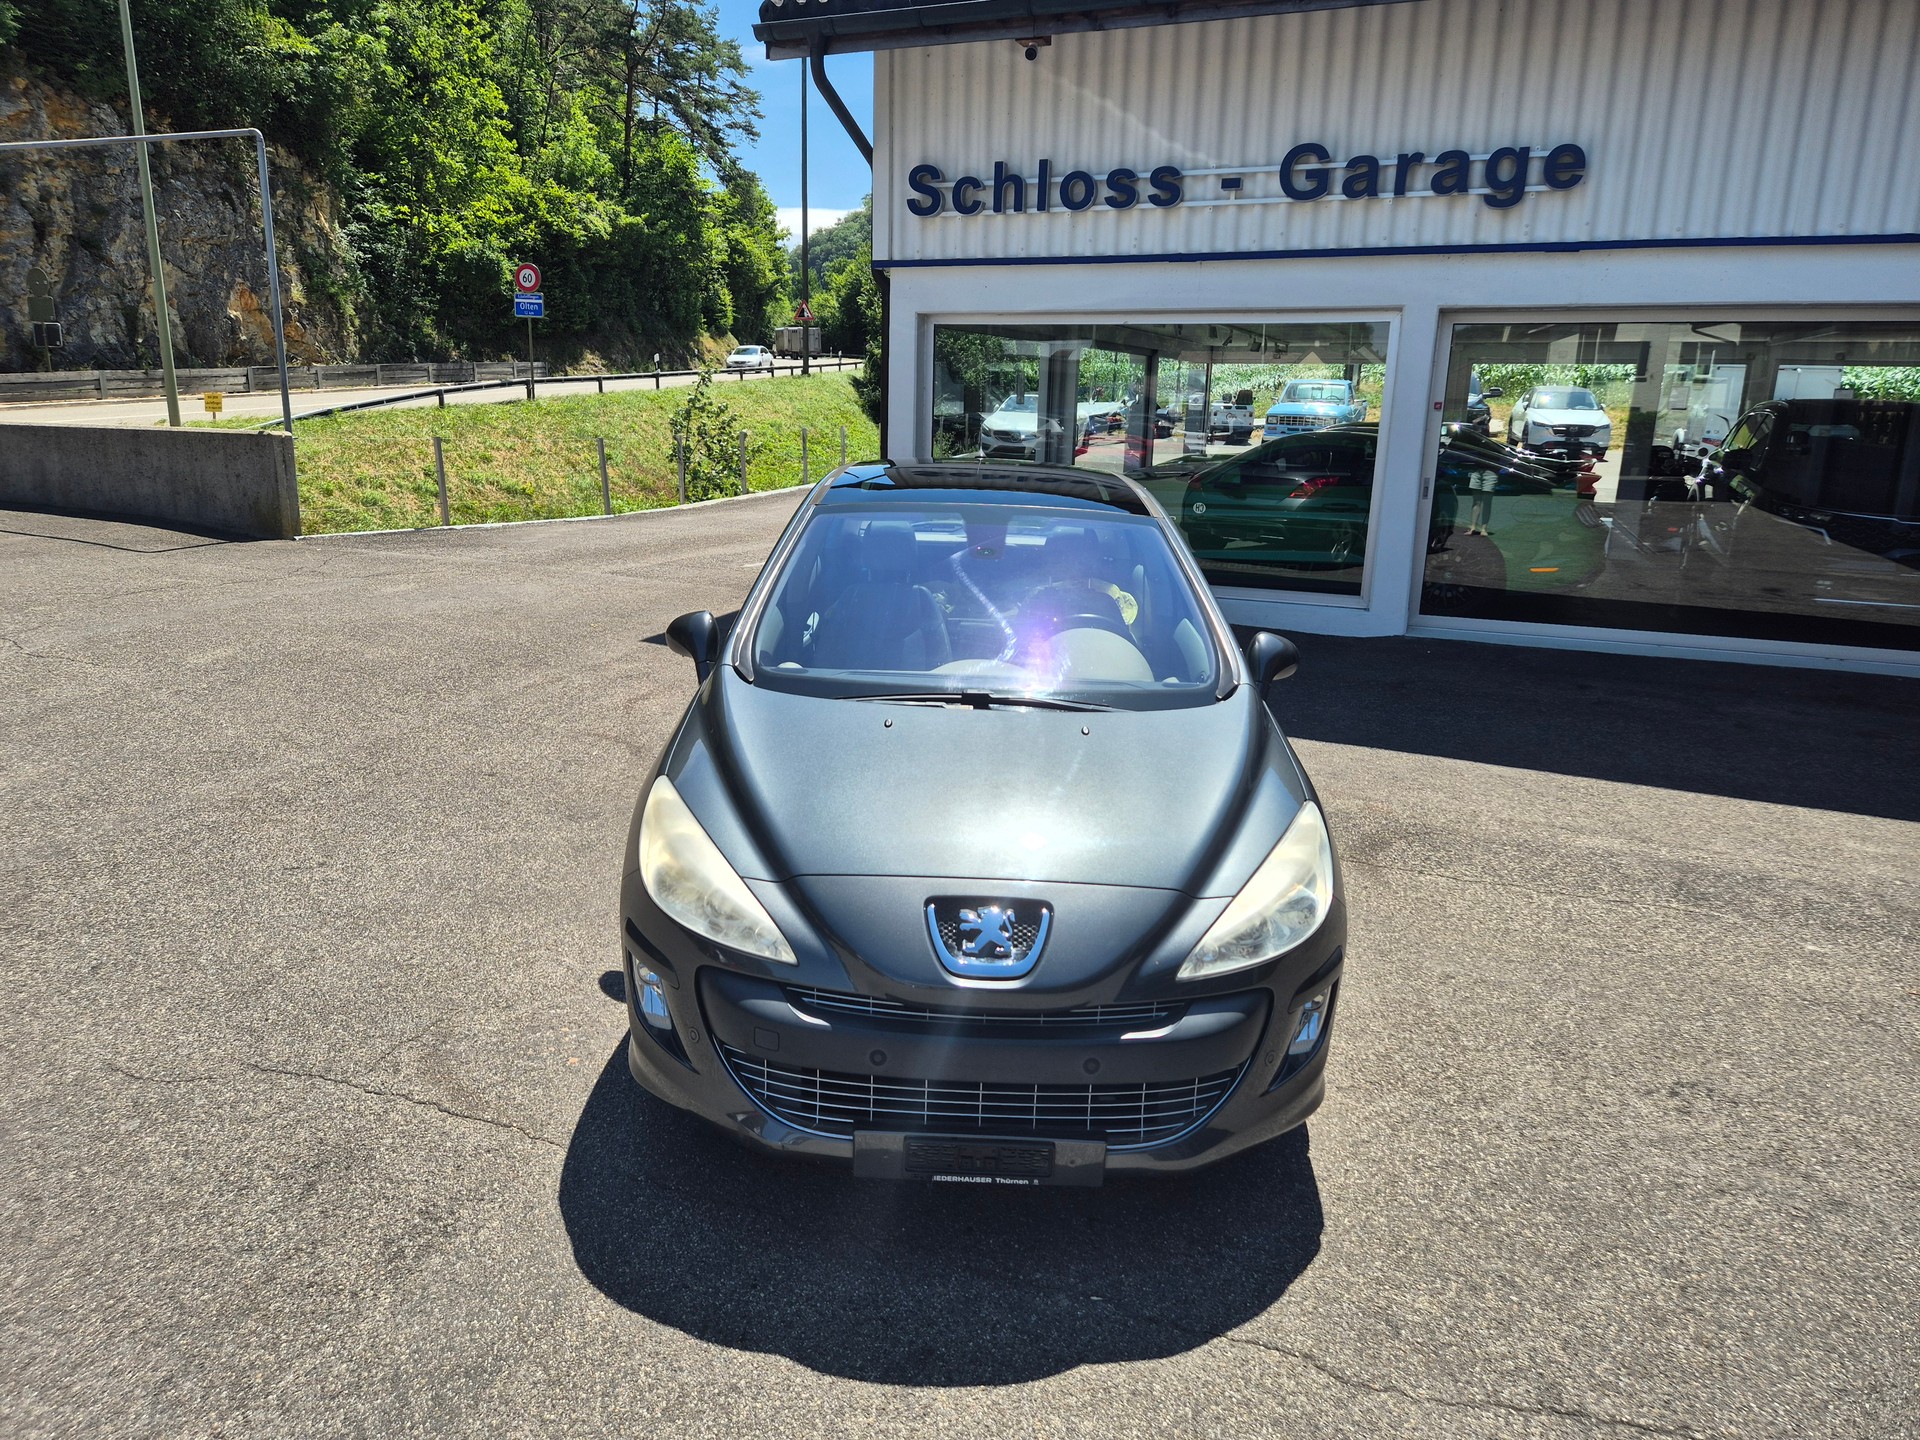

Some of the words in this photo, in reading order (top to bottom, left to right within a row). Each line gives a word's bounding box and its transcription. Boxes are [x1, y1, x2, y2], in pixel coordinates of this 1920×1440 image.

[907, 158, 1183, 217] Schloss
[1279, 142, 1586, 209] Garage
[522, 273, 532, 283] 60
[520, 302, 538, 310] Olten
[932, 1175, 992, 1184] IEDERHAUSER
[995, 1177, 1029, 1185] Thürnen
